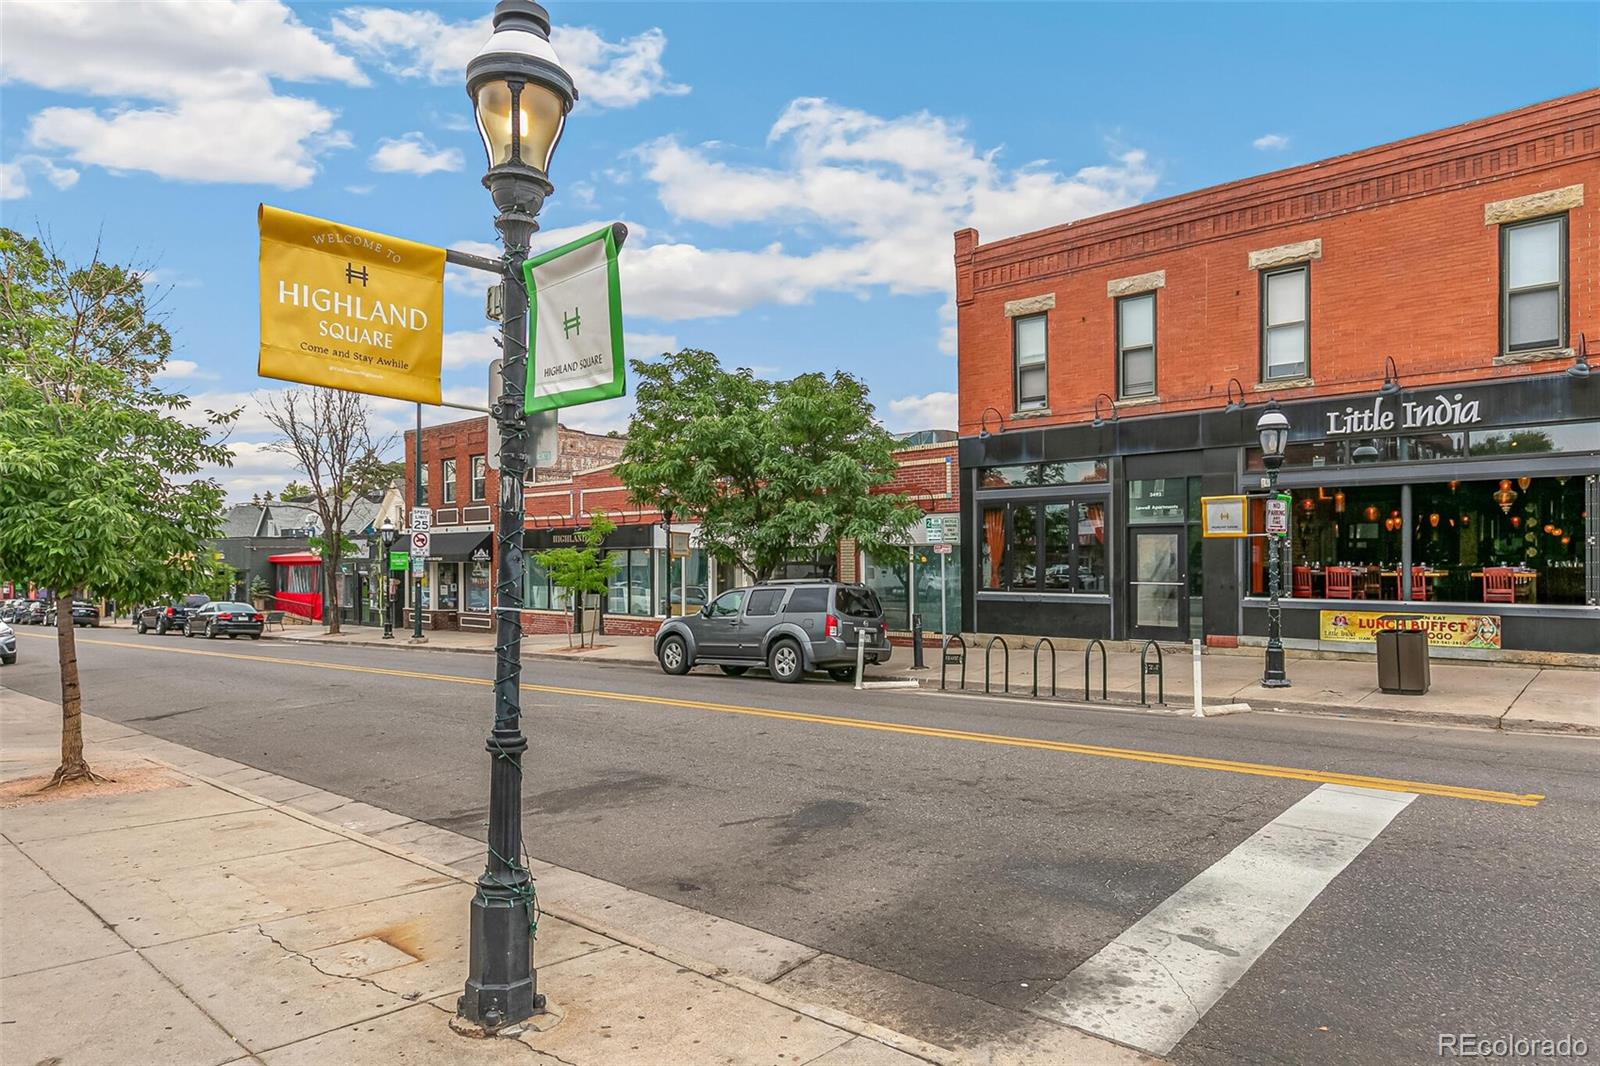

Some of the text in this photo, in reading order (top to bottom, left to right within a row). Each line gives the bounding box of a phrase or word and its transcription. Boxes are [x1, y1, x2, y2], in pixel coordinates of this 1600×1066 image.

[312, 232, 401, 264] WELCOME TO
[278, 280, 428, 331] HIGHLAND
[319, 320, 393, 350] SQUARE
[300, 341, 409, 370] Come and Stay Awhile
[543, 353, 603, 378] HIGHLAND SQUARE
[1326, 393, 1481, 436] Little India
[414, 520, 429, 529] 25
[1358, 618, 1467, 633] LUNCH BUFFET
